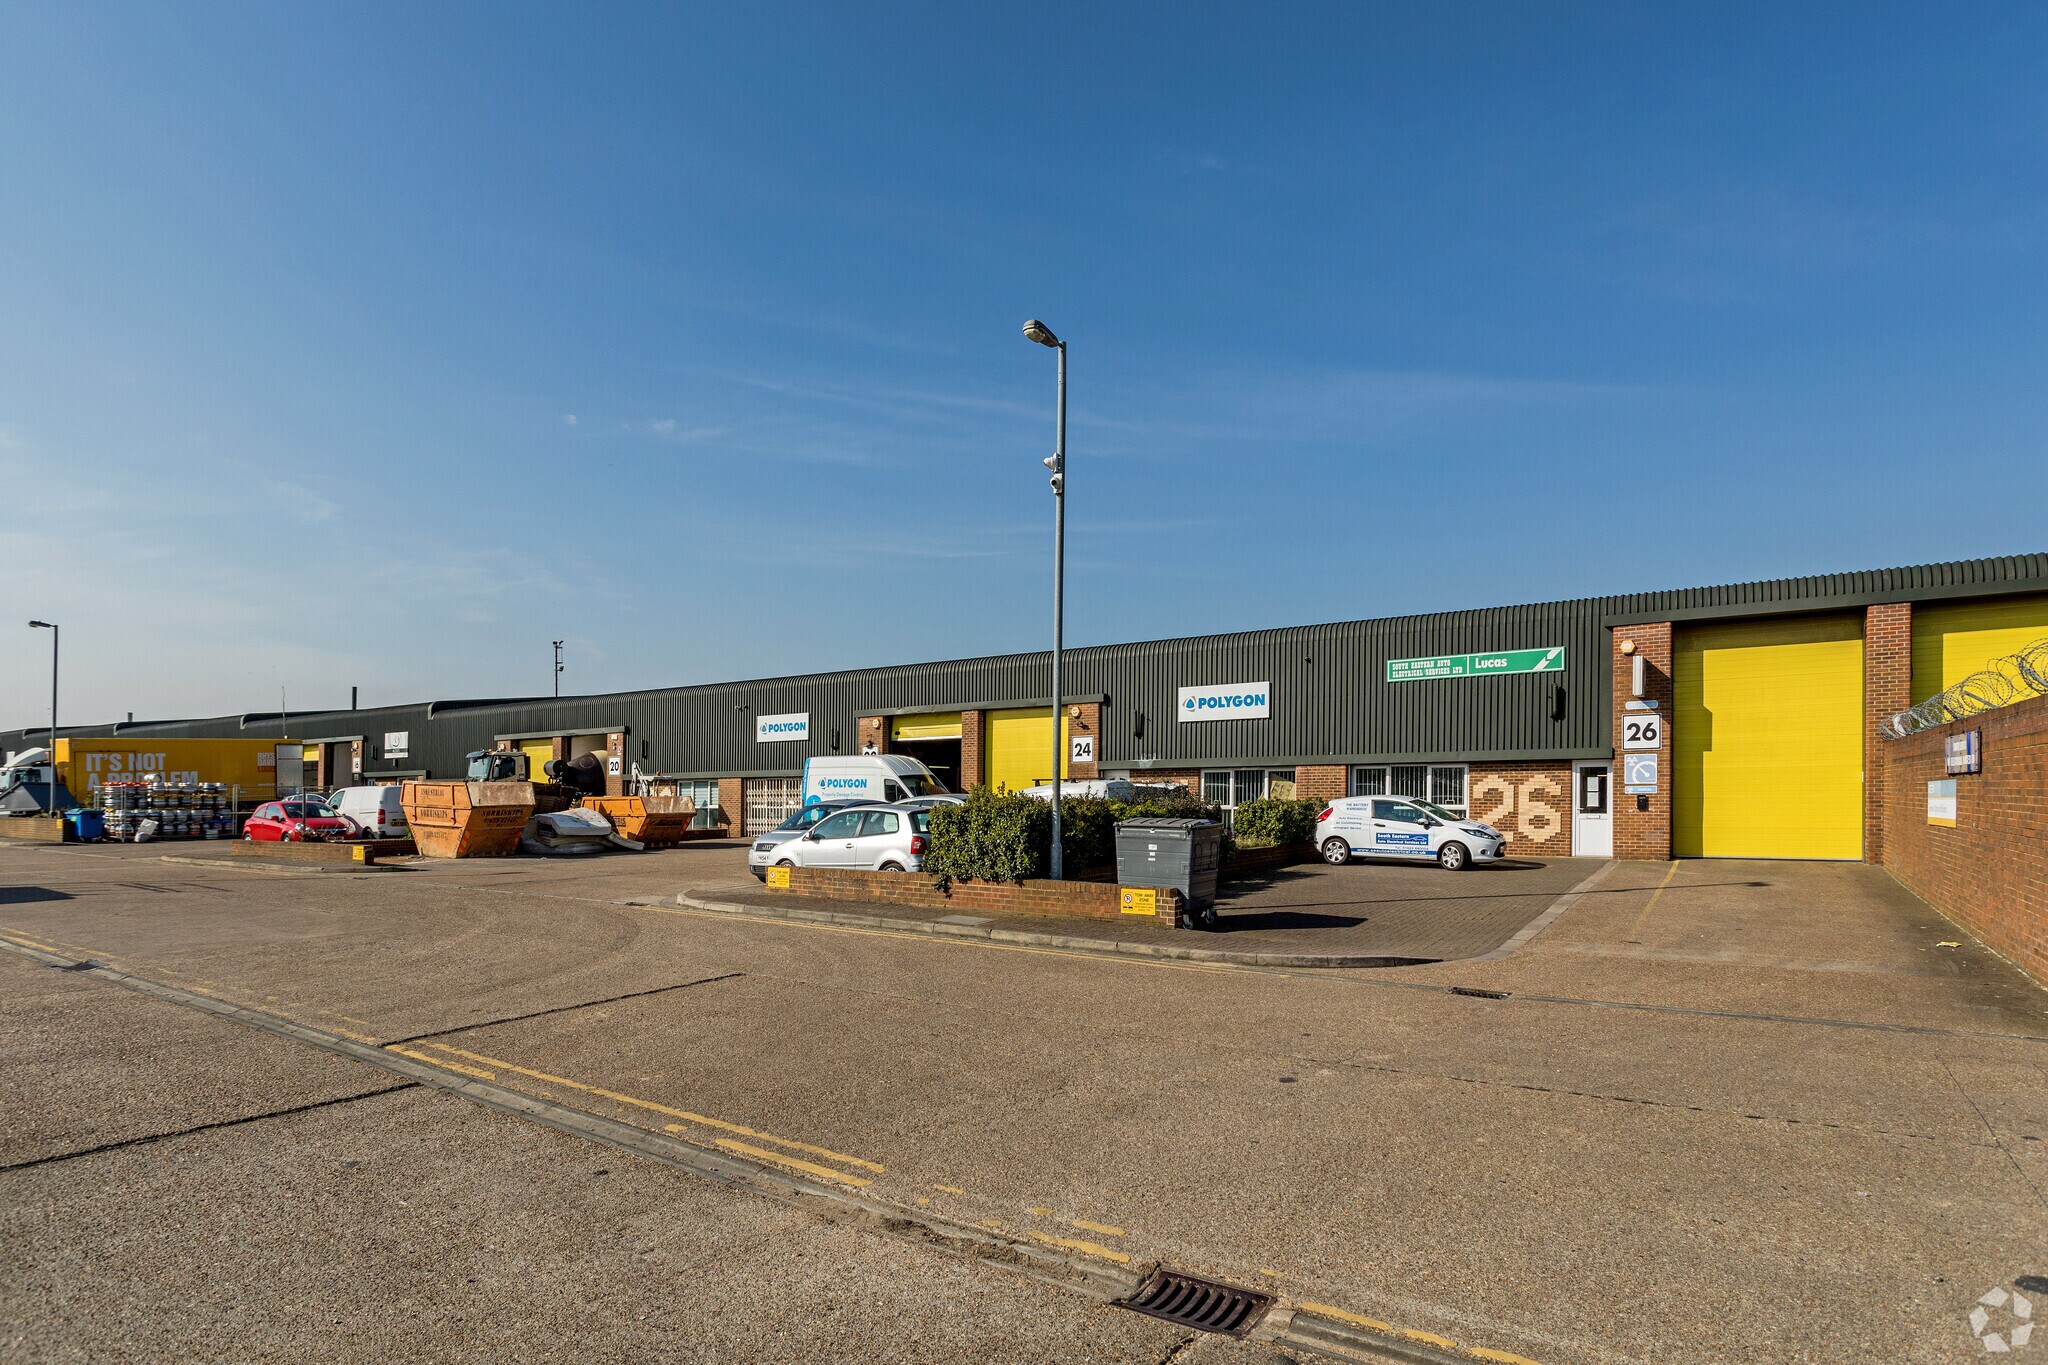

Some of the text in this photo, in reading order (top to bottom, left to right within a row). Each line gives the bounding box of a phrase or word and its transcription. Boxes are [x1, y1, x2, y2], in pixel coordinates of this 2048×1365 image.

[1392, 659, 1451, 671] SOUTH EASTERN AUTO
[1475, 657, 1507, 669] Lucas
[1392, 666, 1463, 678] ELECTRICAL SERVICES LTD
[1198, 693, 1265, 709] POLYGON
[768, 722, 806, 733] POLYGON
[1626, 722, 1657, 741] 26
[1074, 742, 1091, 757] 24
[86, 752, 166, 772] IT'S NOT
[609, 761, 620, 772] 20
[87, 773, 100, 791] A
[827, 778, 867, 788] POLYGON
[1472, 775, 1561, 842] 26
